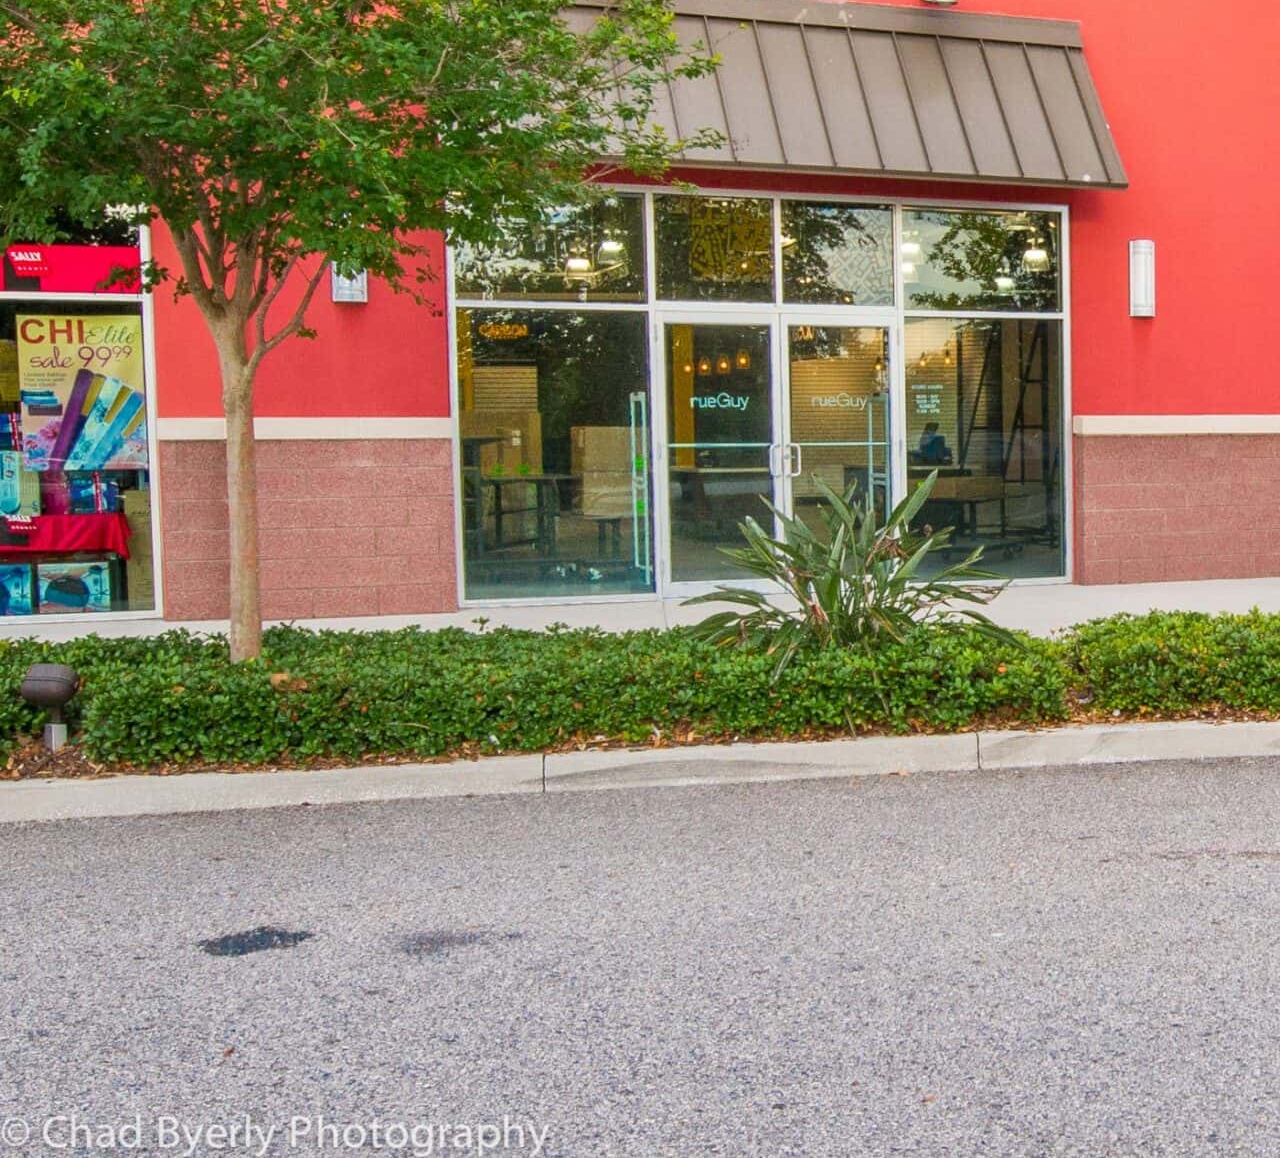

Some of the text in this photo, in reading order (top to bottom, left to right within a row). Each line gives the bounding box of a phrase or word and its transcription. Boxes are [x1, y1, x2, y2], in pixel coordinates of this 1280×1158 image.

[20, 318, 85, 344] CHI
[690, 393, 750, 411] rueGuy
[811, 393, 867, 410] rueGuy
